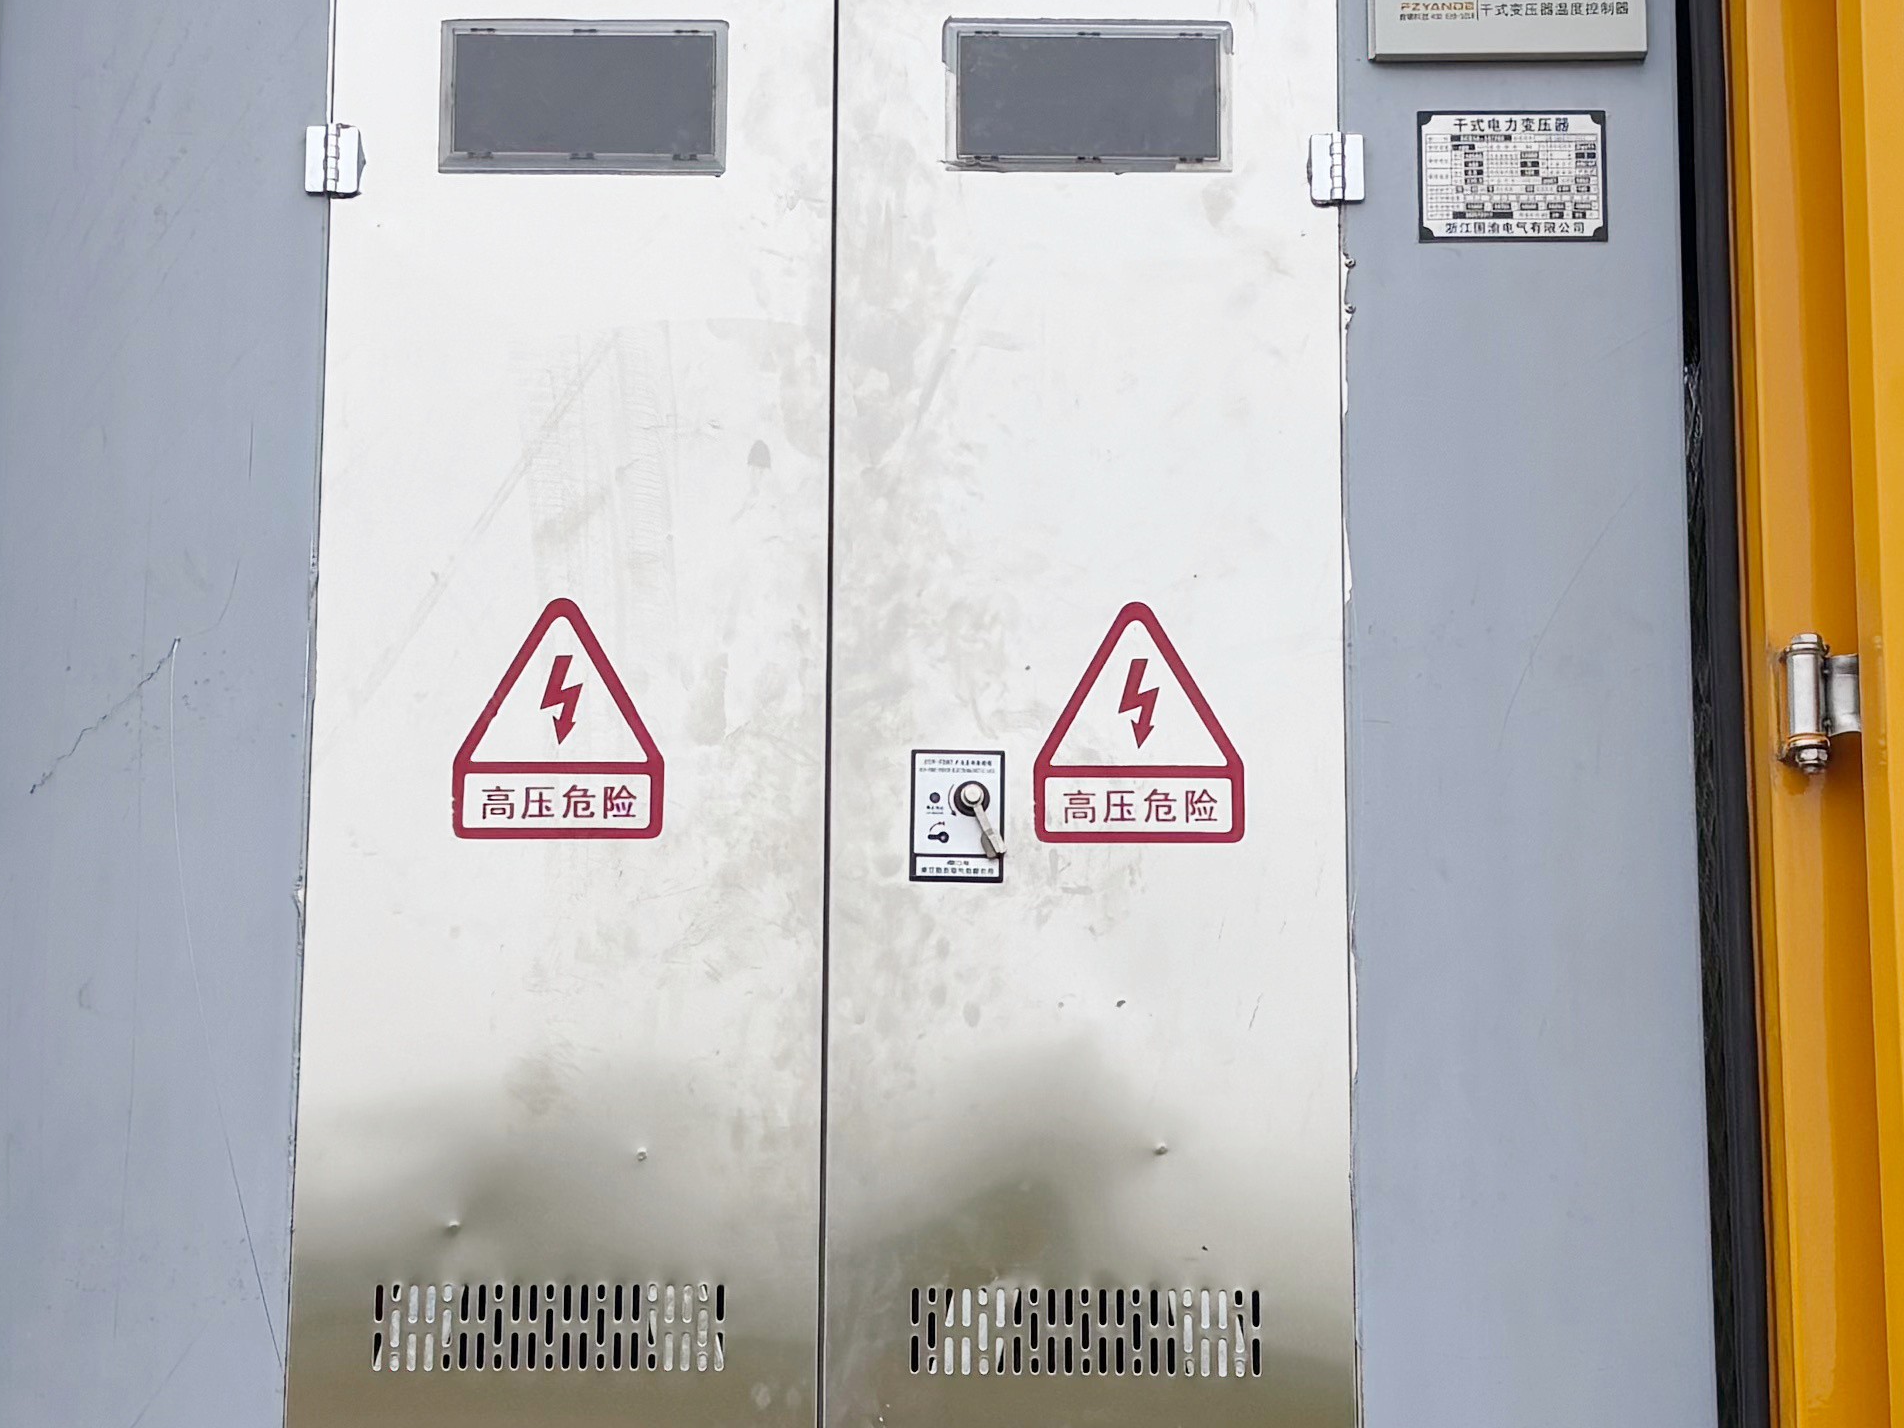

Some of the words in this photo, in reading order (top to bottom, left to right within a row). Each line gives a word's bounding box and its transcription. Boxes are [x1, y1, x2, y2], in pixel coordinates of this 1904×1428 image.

[1480, 1, 1629, 17] 干式变压器温度控制器
[1453, 117, 1569, 133] 干式电力变压器
[481, 785, 639, 821] 高压危险
[1062, 788, 1219, 825] 高压危险
